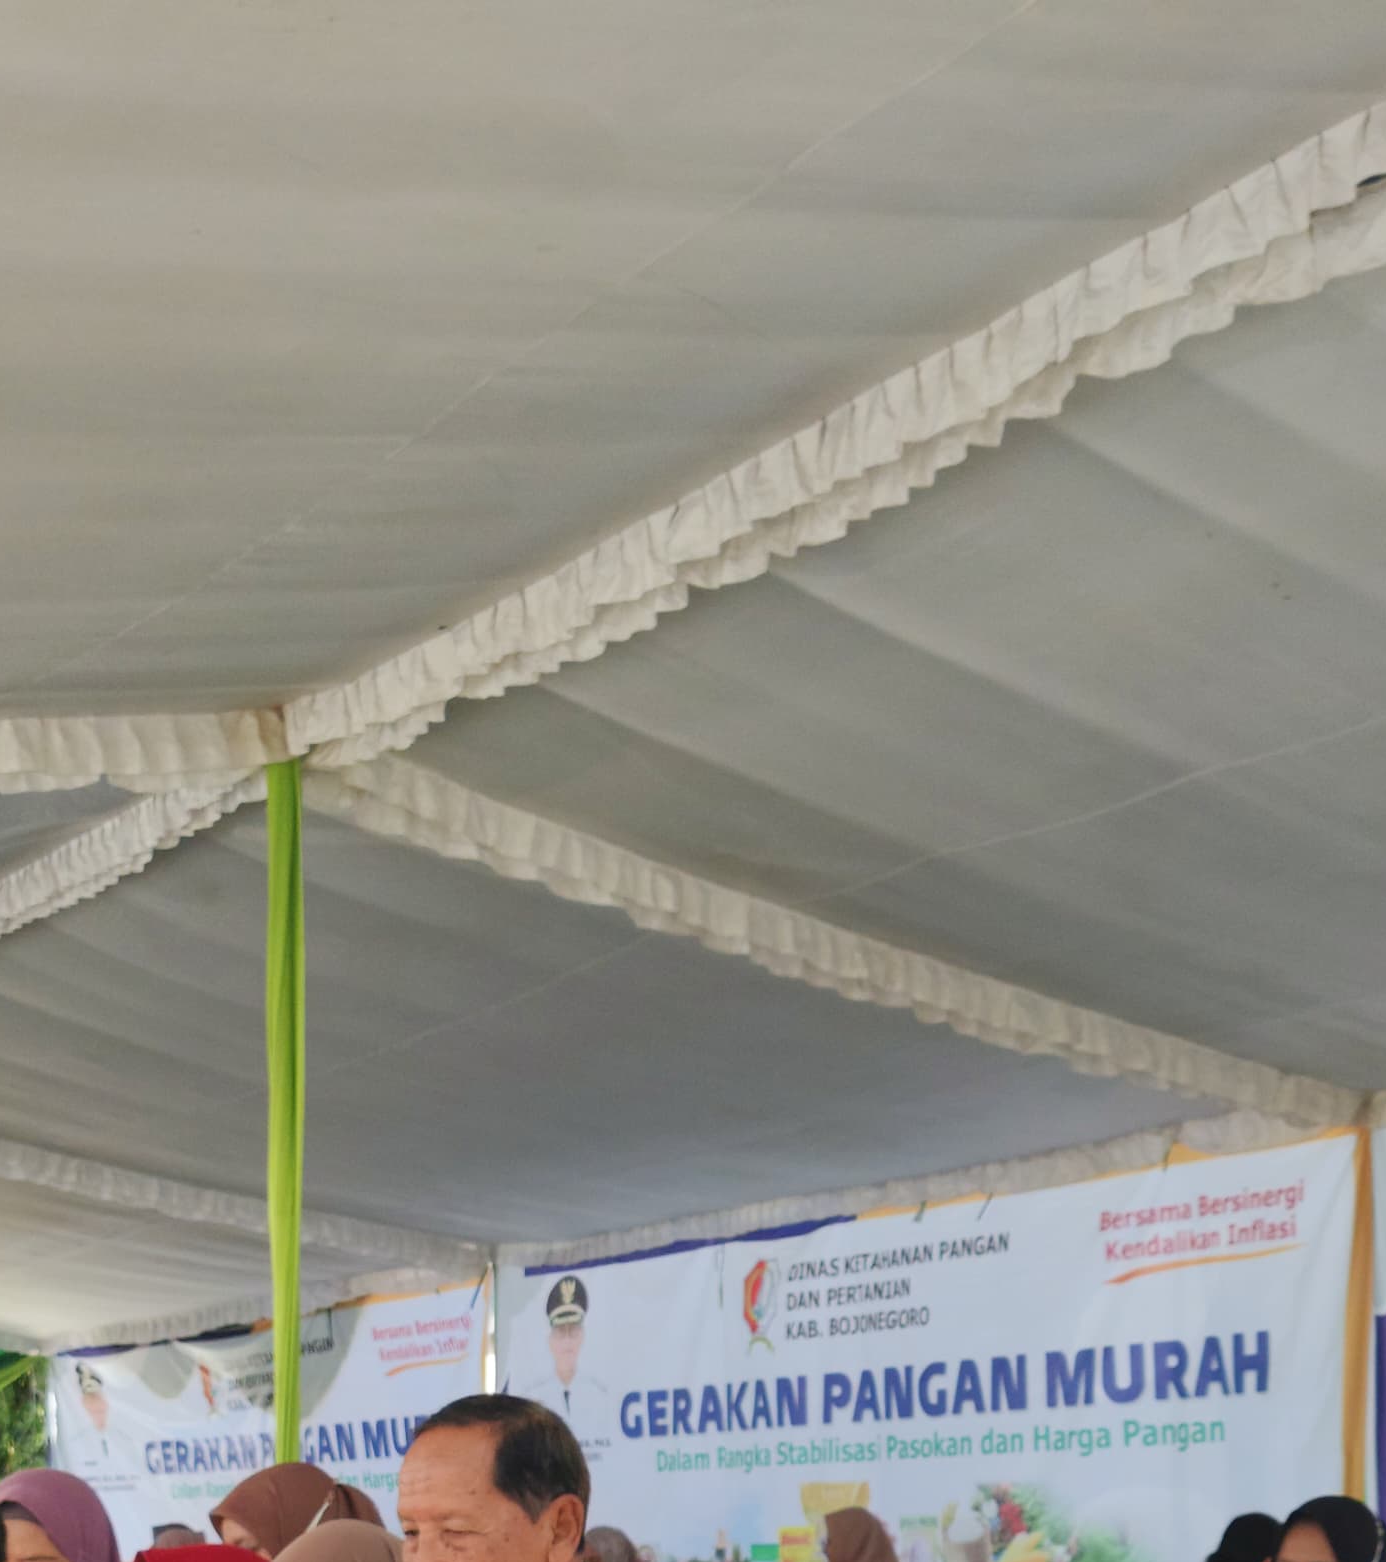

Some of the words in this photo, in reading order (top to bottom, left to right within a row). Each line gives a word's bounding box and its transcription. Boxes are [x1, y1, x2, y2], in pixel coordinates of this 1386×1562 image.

[1099, 1201, 1193, 1232] Bersama
[1198, 1178, 1306, 1217] Bersinergi
[788, 1258, 839, 1282] DINAS
[844, 1244, 934, 1274] KETAHANAN
[939, 1232, 1010, 1261] PANGAN
[1105, 1231, 1221, 1262] Kendalikan
[1227, 1215, 1297, 1246] Inflasi
[786, 1292, 820, 1312] DAN
[826, 1278, 911, 1308] PERTANIAN
[785, 1320, 824, 1341] KAB.
[829, 1306, 930, 1337] BOJONEGORO
[620, 1375, 808, 1439] GERAKAN
[822, 1353, 1027, 1424] PANGAN
[1045, 1330, 1269, 1409] MURAH
[656, 1449, 710, 1473] Dalam
[777, 1436, 882, 1467] Stabilisasi
[886, 1431, 973, 1460] Pasokan
[980, 1428, 1024, 1455] dan
[1033, 1424, 1111, 1457] Harga
[1123, 1419, 1226, 1453] Pangan
